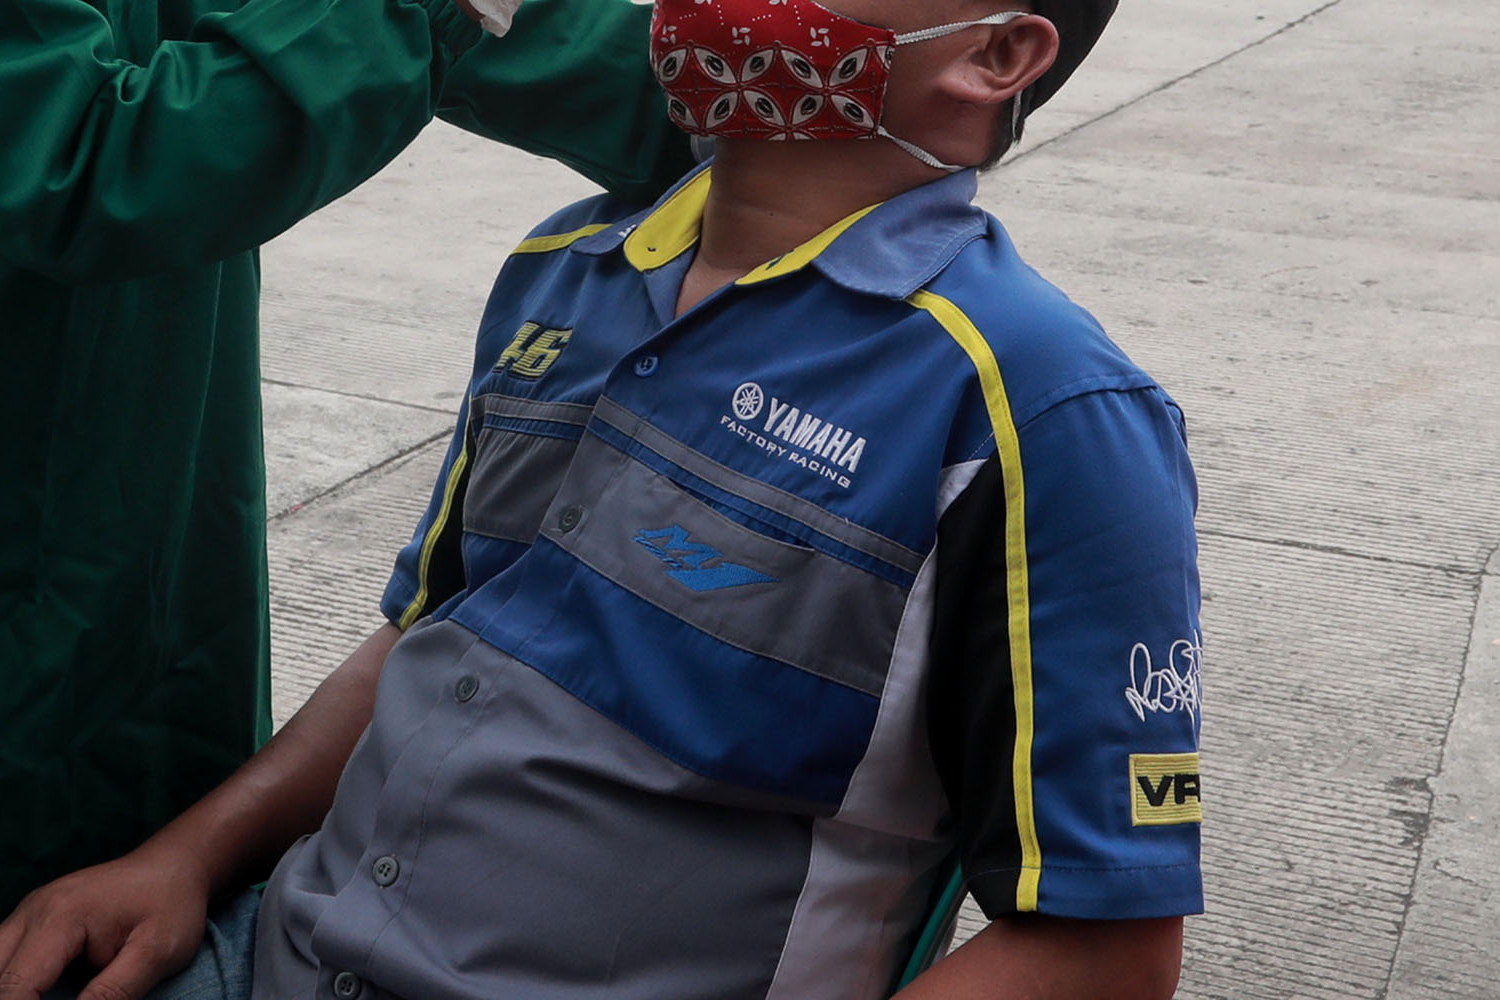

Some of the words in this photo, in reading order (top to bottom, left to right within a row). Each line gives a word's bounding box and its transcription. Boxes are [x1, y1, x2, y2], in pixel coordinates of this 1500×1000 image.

[492, 320, 573, 382] 46
[720, 415, 787, 457] FACTORY
[788, 452, 852, 489] RACING
[763, 397, 867, 474] YAMAHA
